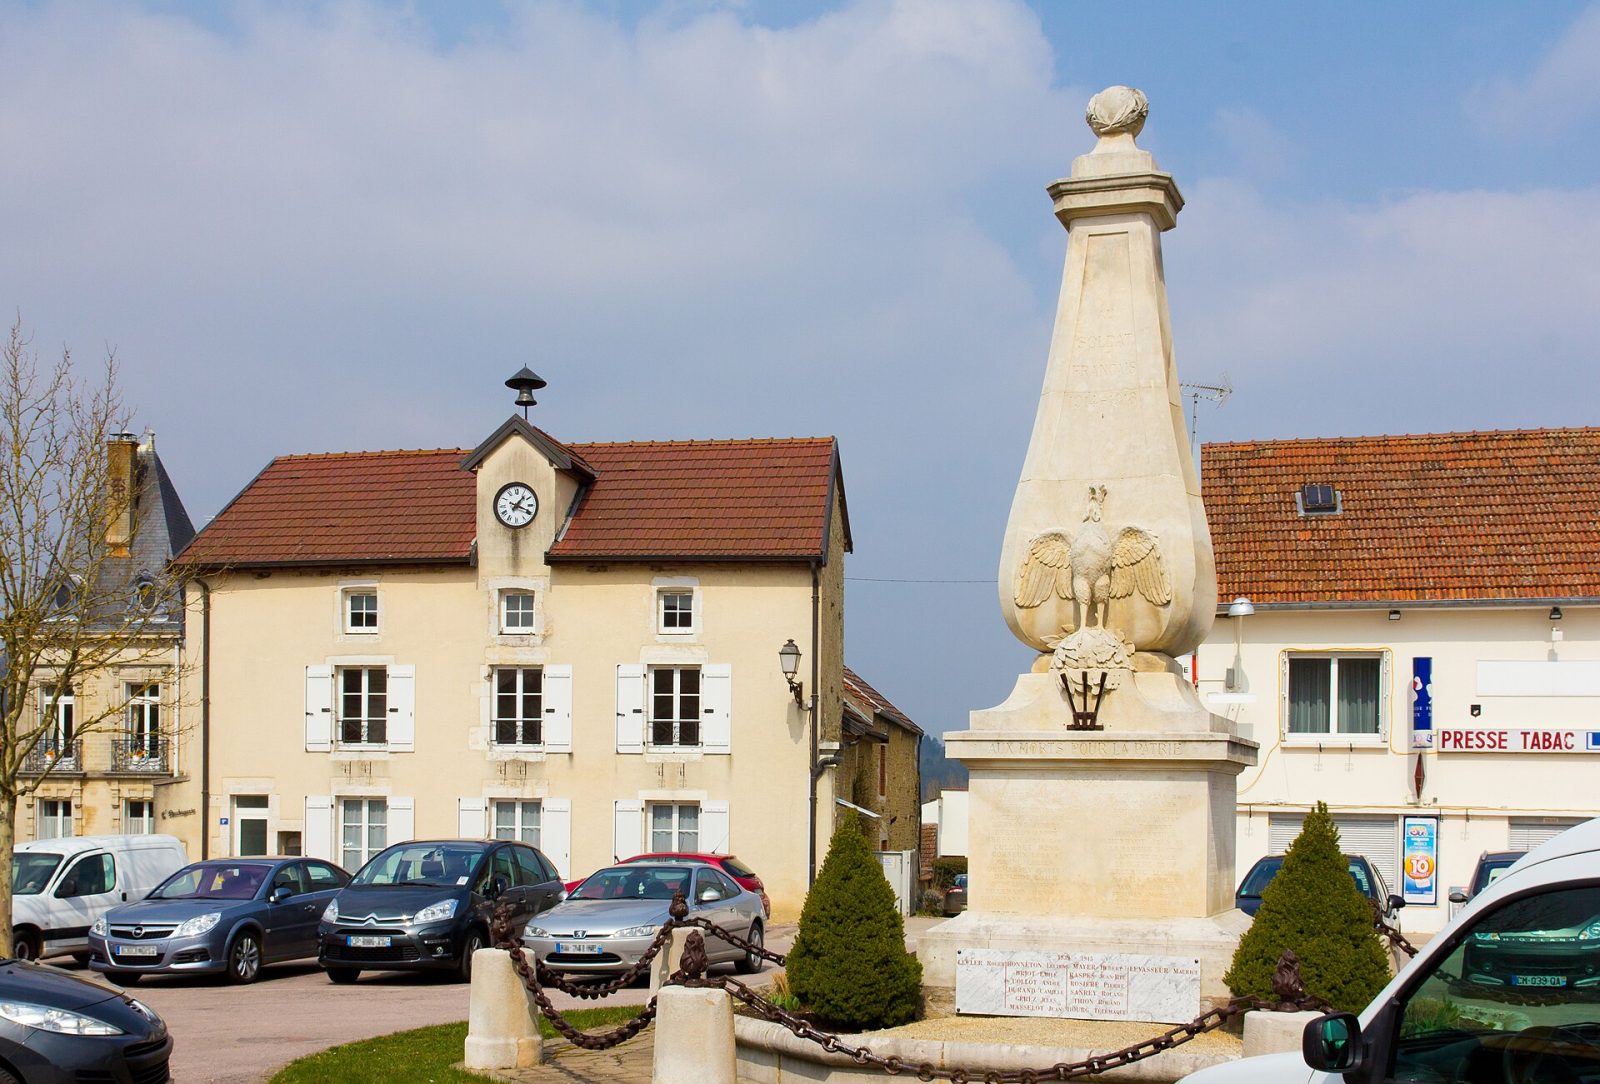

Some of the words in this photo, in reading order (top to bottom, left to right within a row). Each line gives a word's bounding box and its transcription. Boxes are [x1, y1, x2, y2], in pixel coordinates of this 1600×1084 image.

[1441, 730, 1508, 750] PRESSE
[1520, 731, 1575, 750] TABAC
[1071, 742, 1109, 756] POUR
[1135, 742, 1184, 757] PATRIE
[1410, 858, 1429, 875] 10
